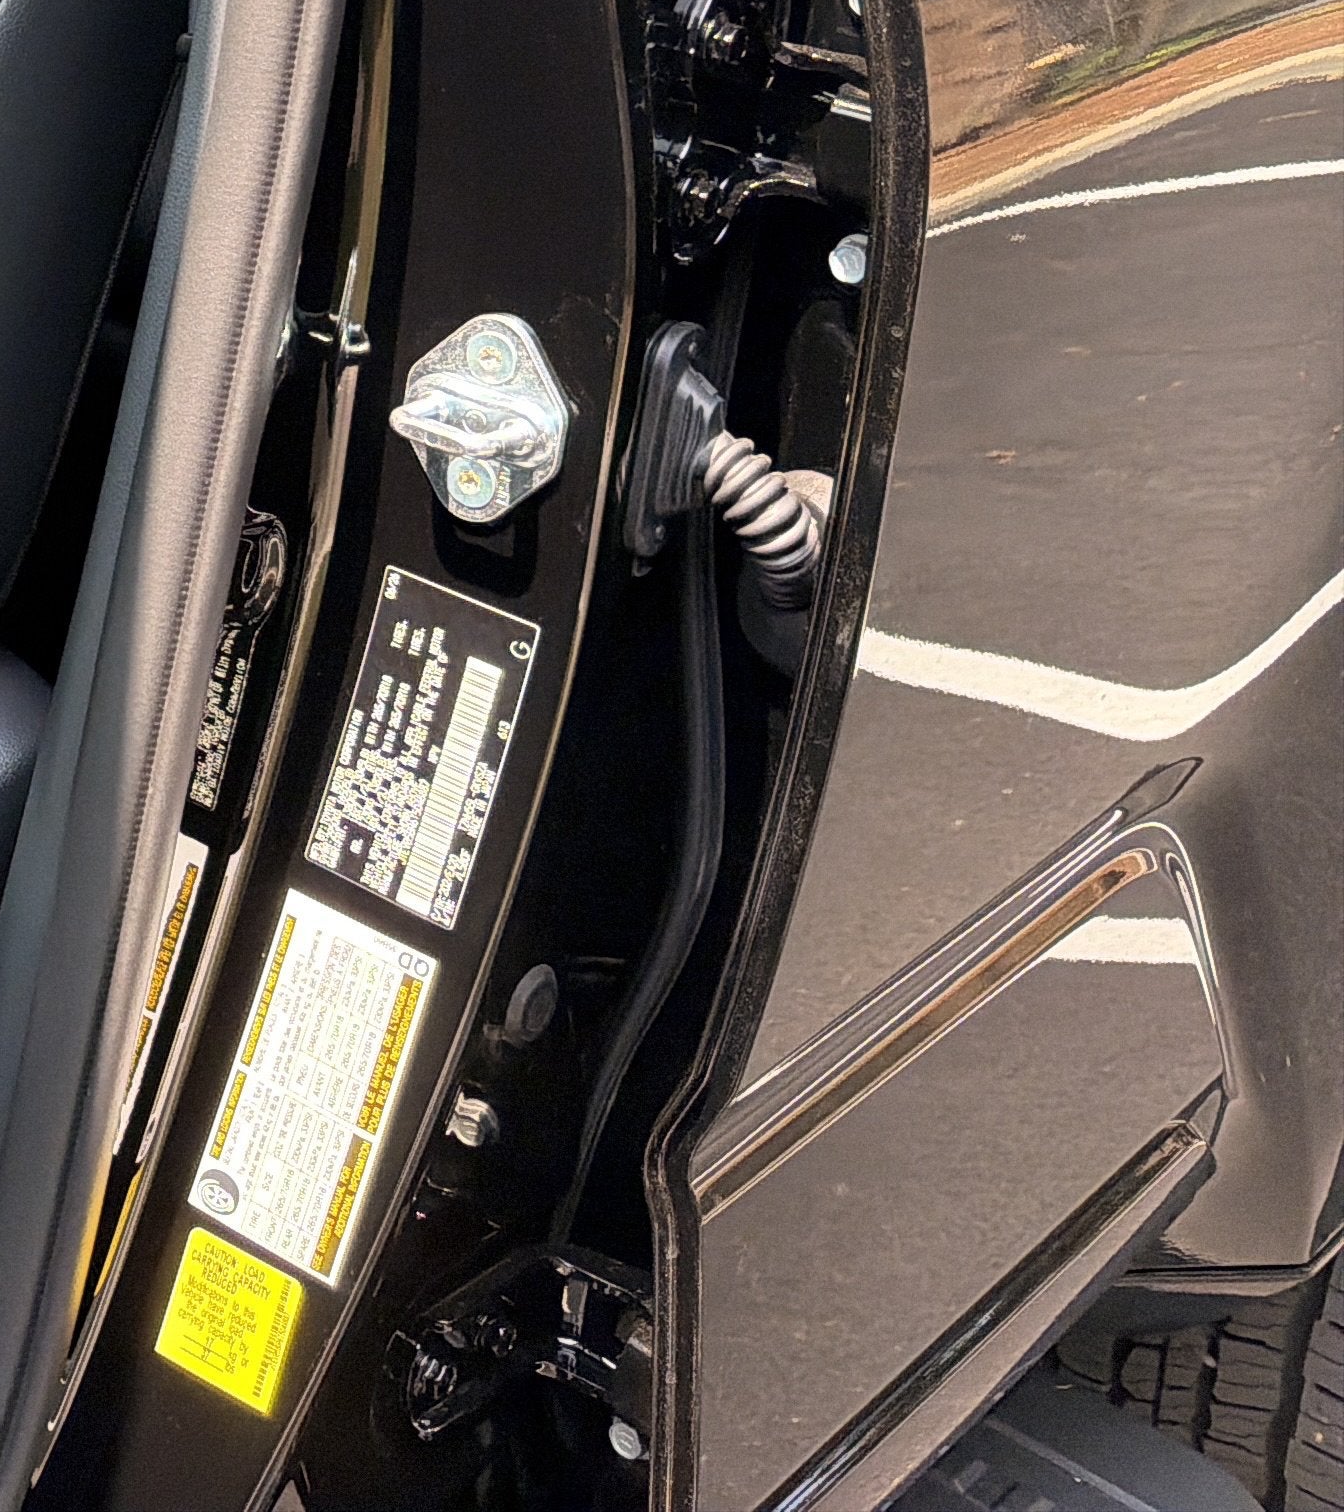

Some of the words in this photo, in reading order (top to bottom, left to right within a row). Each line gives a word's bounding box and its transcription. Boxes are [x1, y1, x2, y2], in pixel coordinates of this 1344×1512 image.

[506, 636, 533, 662] G
[337, 706, 365, 768] CORPORATION
[328, 764, 347, 795] MOTOR
[388, 978, 423, 1063] RENSEIGNEMENTS
[381, 1031, 395, 1048] DE
[369, 1048, 390, 1089] MANUEL
[383, 1062, 396, 1080] DE
[364, 1088, 377, 1105] LE
[374, 1078, 391, 1106] PLUS
[356, 1103, 372, 1130] VOIR
[365, 1105, 383, 1135] POUR
[332, 1190, 355, 1239] ADDITIONAL
[347, 1139, 372, 1193] INFORMATION
[310, 1251, 324, 1271] SEE
[327, 1182, 346, 1218] MANUAL
[338, 1163, 352, 1185] FOR
[190, 1247, 230, 1279] CARRYING
[231, 1270, 271, 1302] CAPACITY
[200, 1265, 238, 1296] REDUCED
[242, 1262, 266, 1284] LOAD
[205, 1298, 226, 1317] have
[226, 1309, 257, 1334] reduced
[230, 1299, 241, 1313] to
[241, 1305, 257, 1322] this
